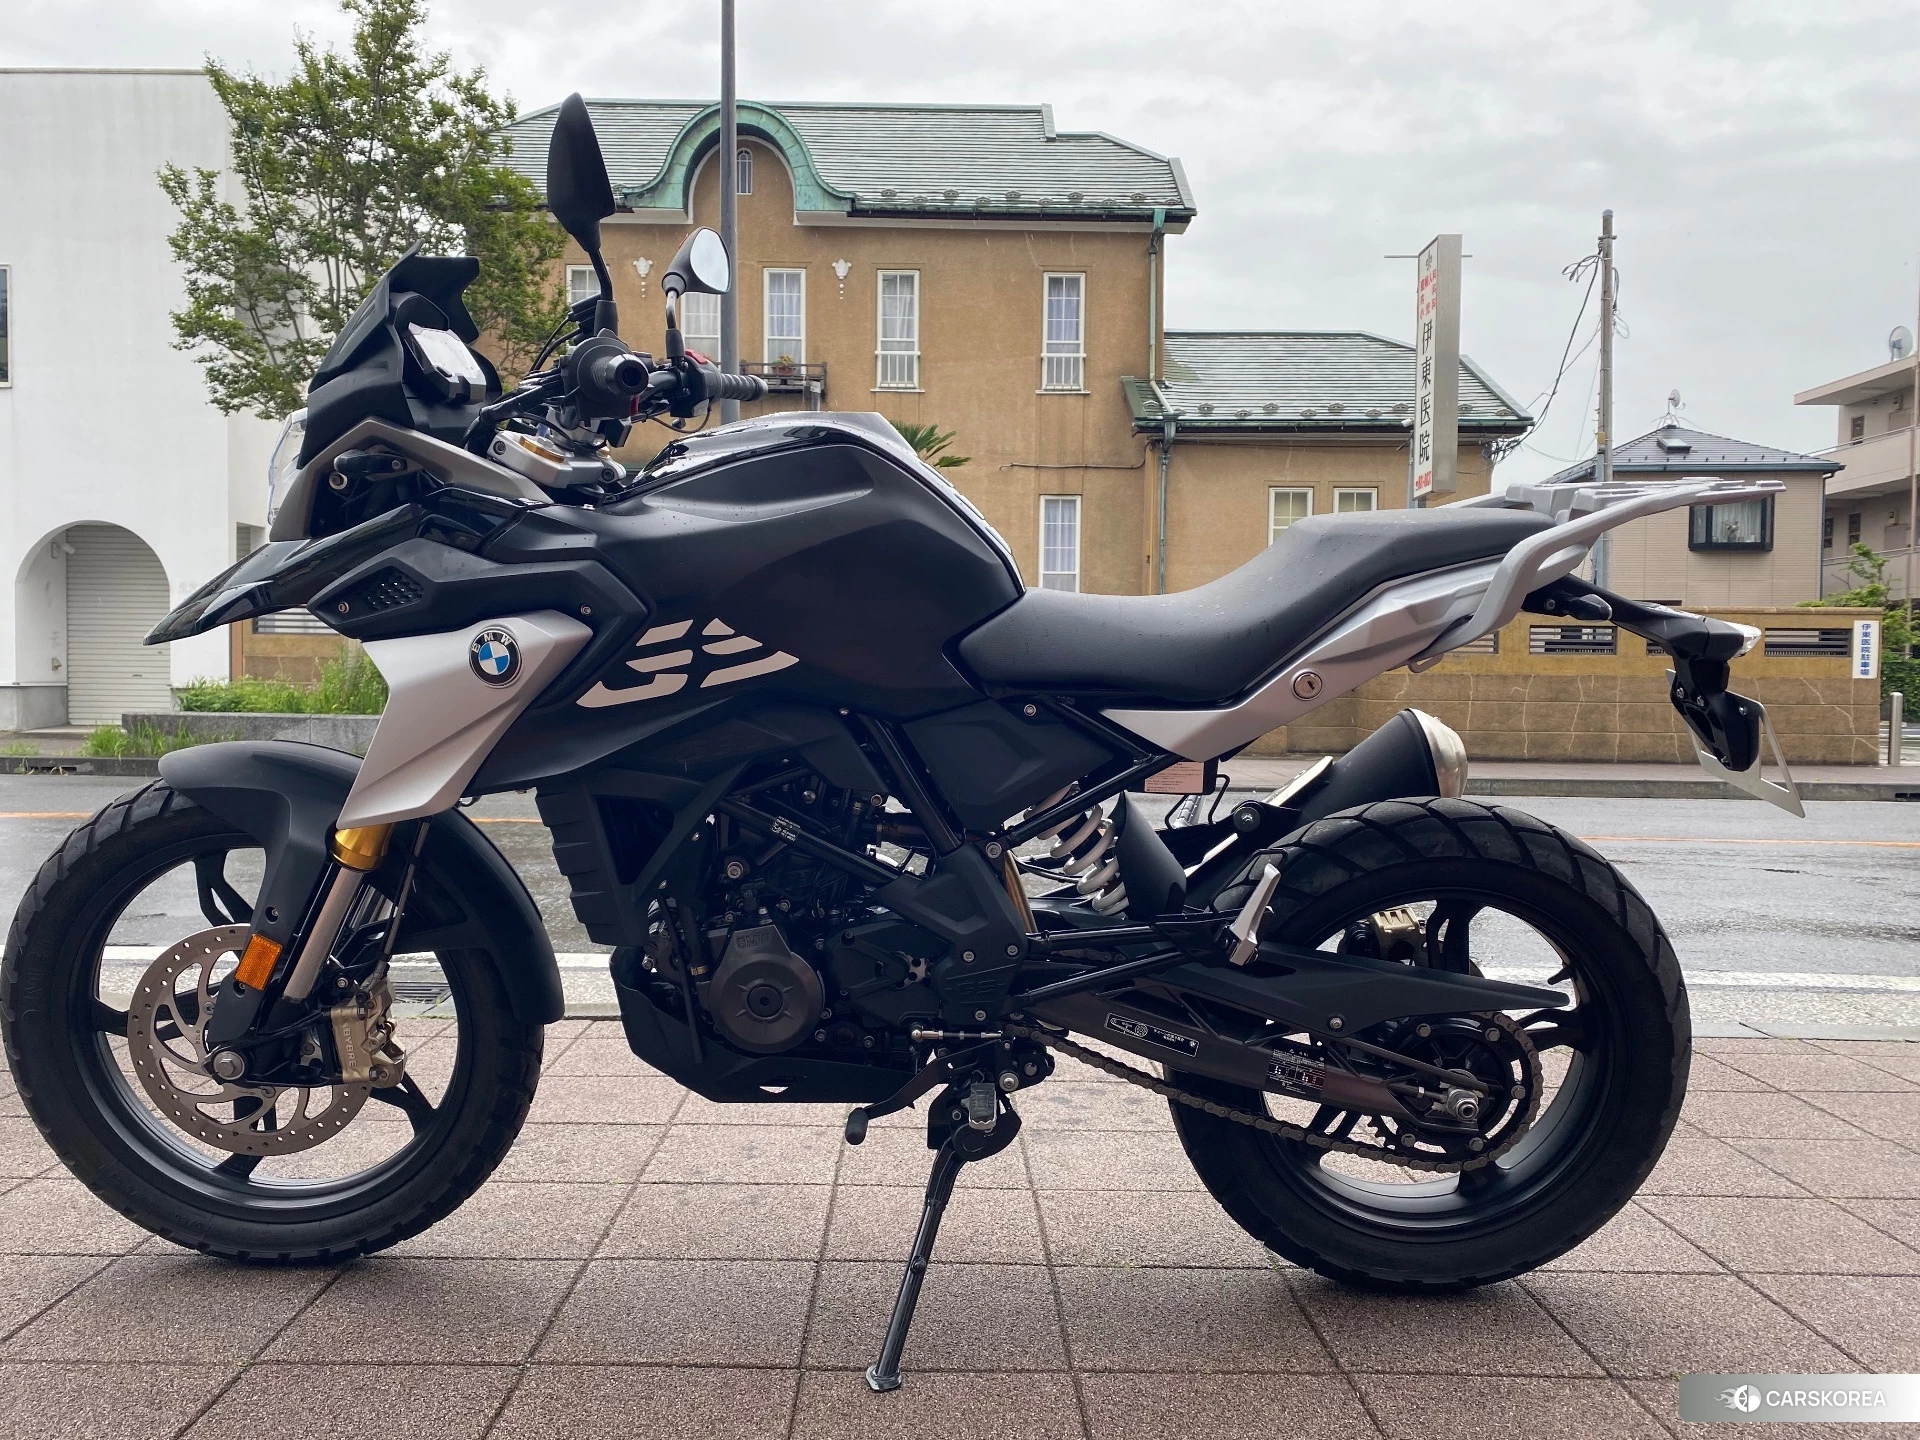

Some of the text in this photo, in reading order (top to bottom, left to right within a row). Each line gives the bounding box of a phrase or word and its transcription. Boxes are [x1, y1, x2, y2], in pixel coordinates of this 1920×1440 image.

[1418, 318, 1433, 466] 伊東医院
[471, 632, 512, 653] BMW
[1860, 623, 1872, 676] 伊東医院駐車場
[343, 1028, 358, 1068] BYBRE
